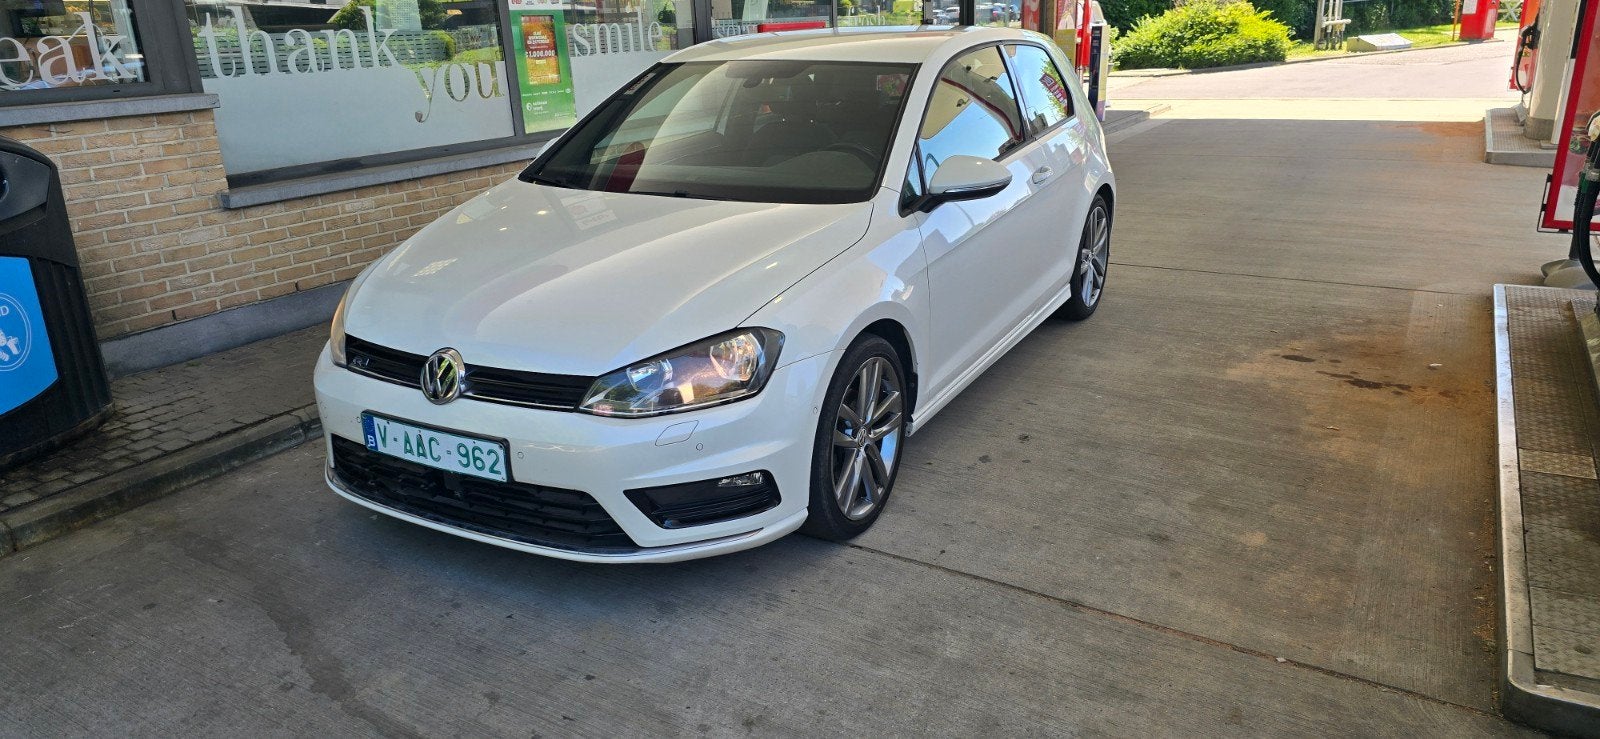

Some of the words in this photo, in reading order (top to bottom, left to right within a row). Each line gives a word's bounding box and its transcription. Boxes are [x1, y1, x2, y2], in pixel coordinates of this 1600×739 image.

[197, 6, 402, 80] thank
[572, 6, 663, 57] smile
[401, 60, 505, 123] you
[367, 434, 376, 447] B
